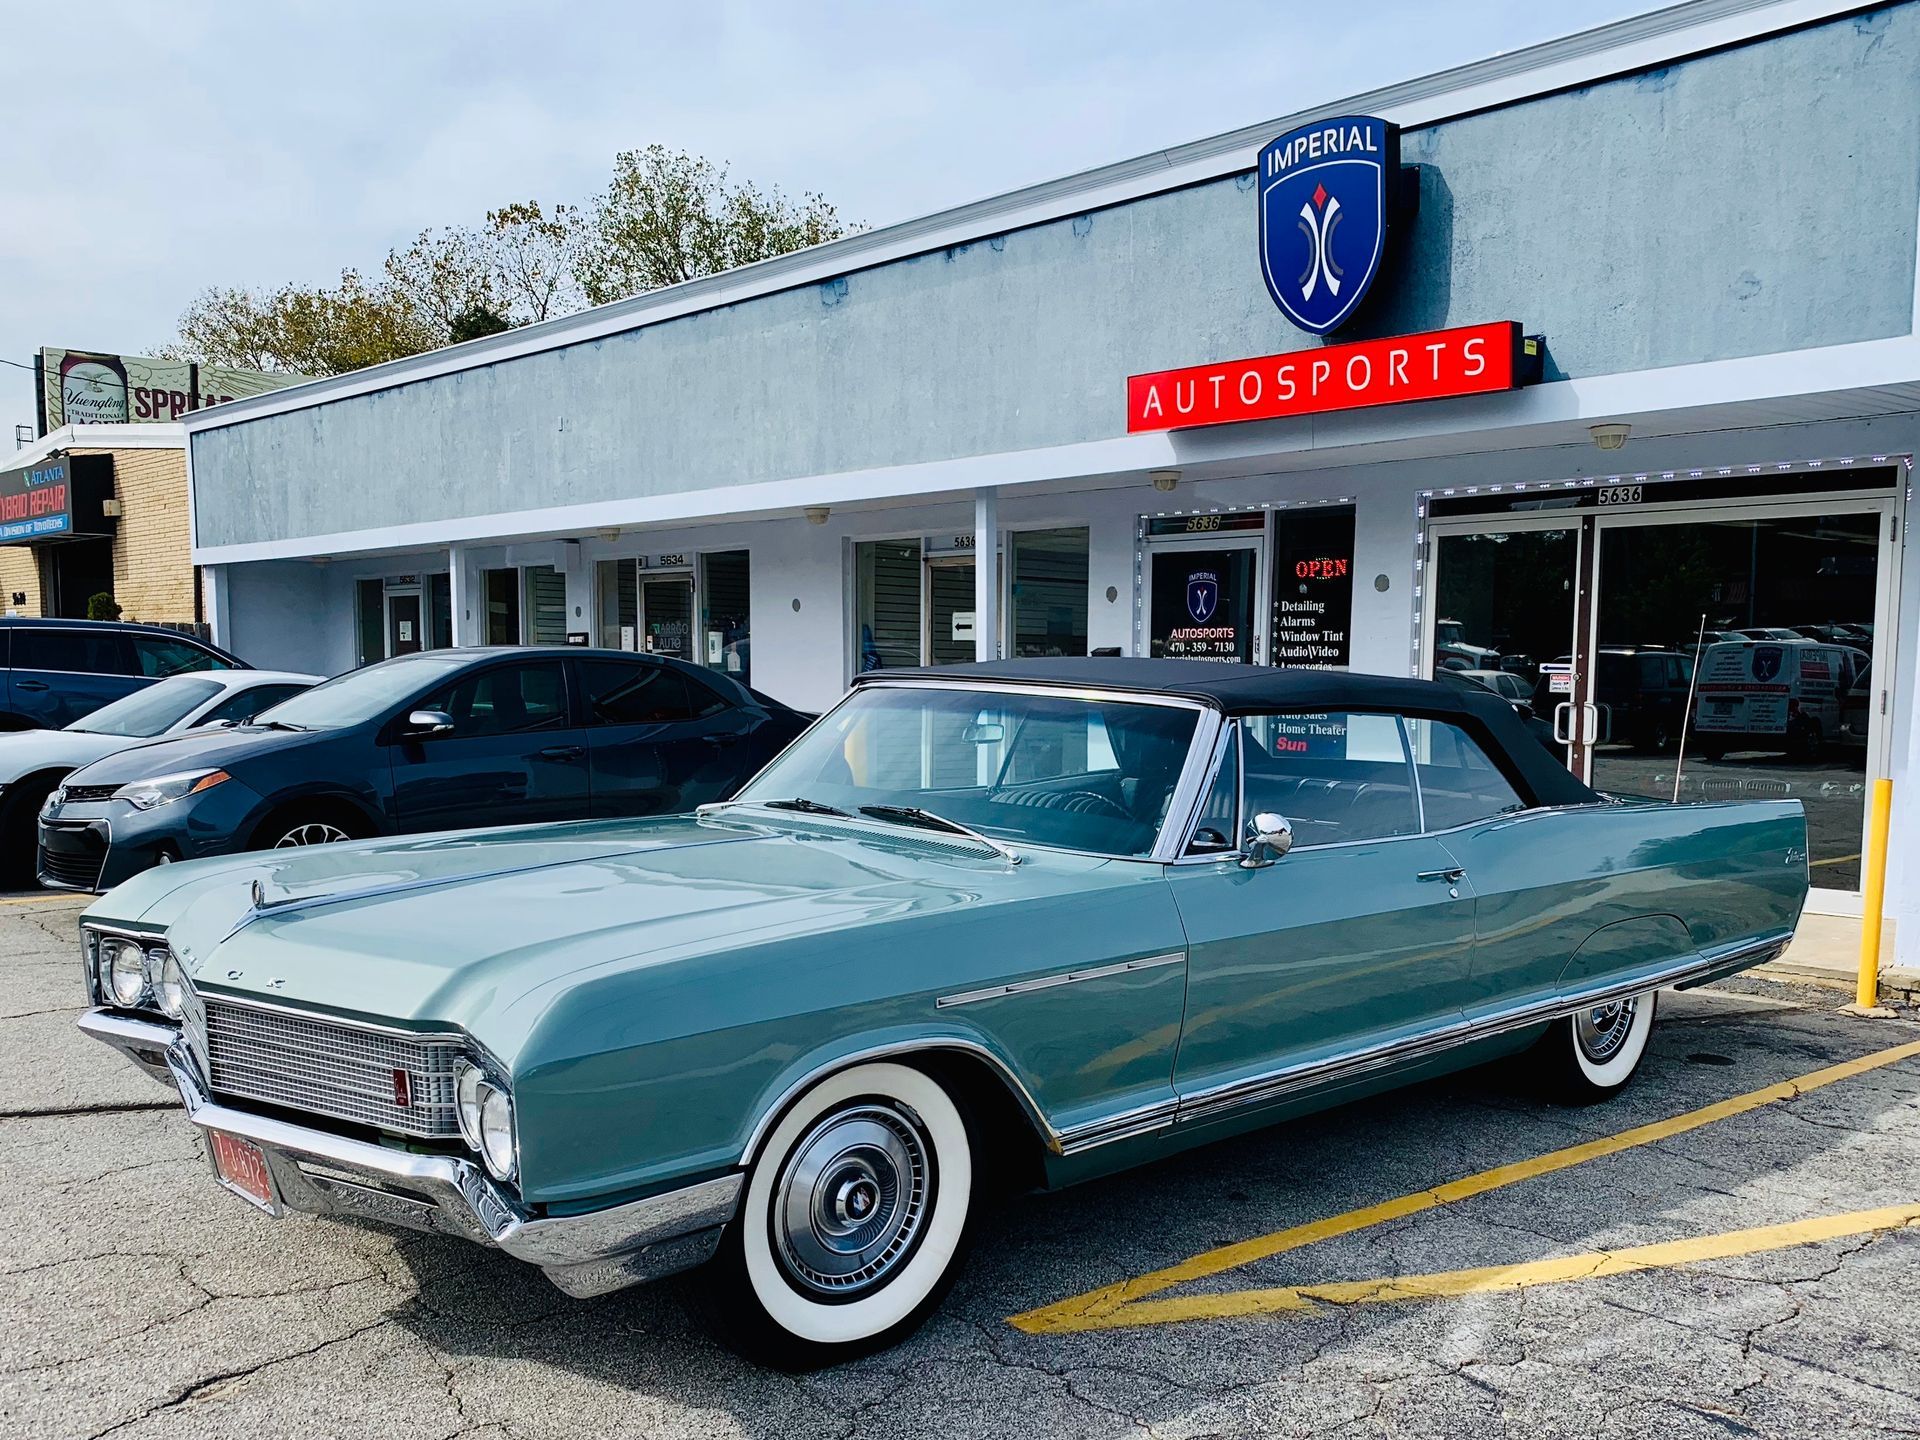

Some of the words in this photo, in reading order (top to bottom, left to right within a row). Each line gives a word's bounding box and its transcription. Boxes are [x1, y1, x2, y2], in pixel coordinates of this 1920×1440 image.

[1267, 125, 1378, 177] IMPERIAL
[1142, 338, 1486, 419] AUTOSPORTS
[64, 387, 124, 413] Yuengling
[135, 386, 235, 421] SPR
[71, 409, 121, 419] TRADITIONAL
[31, 465, 64, 486] ATLANTA
[30, 484, 65, 516] REPAIR
[1600, 487, 1641, 504] 5636
[1187, 516, 1219, 531] 5636
[954, 536, 976, 547] 5636
[660, 555, 683, 565] 5634
[1295, 559, 1348, 579] OPEN
[1188, 572, 1217, 582] IMPERIAL
[1281, 600, 1325, 613] Detailing
[1280, 616, 1315, 627] Alarms
[1170, 627, 1235, 639] AUTOSPORTS
[1281, 630, 1320, 642] Window
[1322, 630, 1344, 642] Tint
[1169, 642, 1185, 653] 470
[1191, 641, 1207, 652] 359
[1214, 641, 1235, 652] 7130
[1278, 723, 1306, 735] Home
[1308, 723, 1347, 736] Theater
[1276, 736, 1308, 752] Sun
